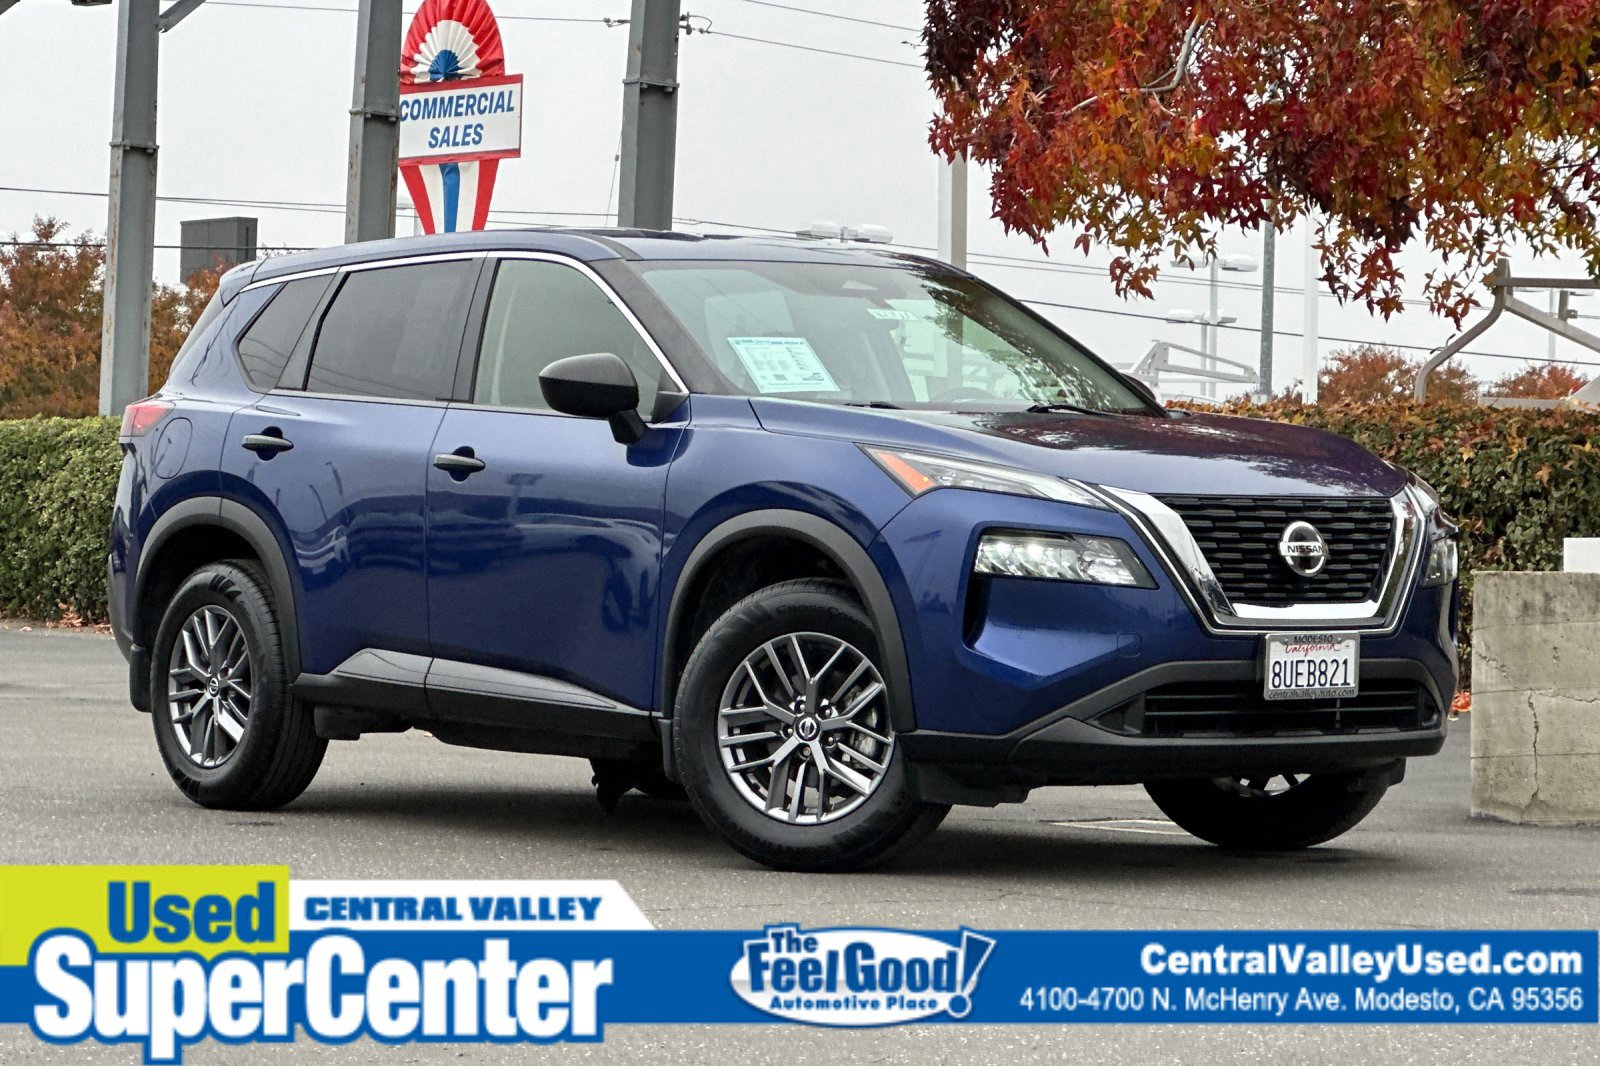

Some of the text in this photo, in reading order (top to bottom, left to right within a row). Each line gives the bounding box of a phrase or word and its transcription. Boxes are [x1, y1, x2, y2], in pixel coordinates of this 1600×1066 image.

[399, 90, 515, 122] COMMERCIAL
[428, 123, 484, 149] SALES
[1287, 544, 1323, 554] NISSAN
[1294, 634, 1334, 643] MODESTO
[1284, 642, 1341, 657] California
[1271, 658, 1351, 689] 8UEB821
[1269, 688, 1355, 700] centralvalleyauto.com
